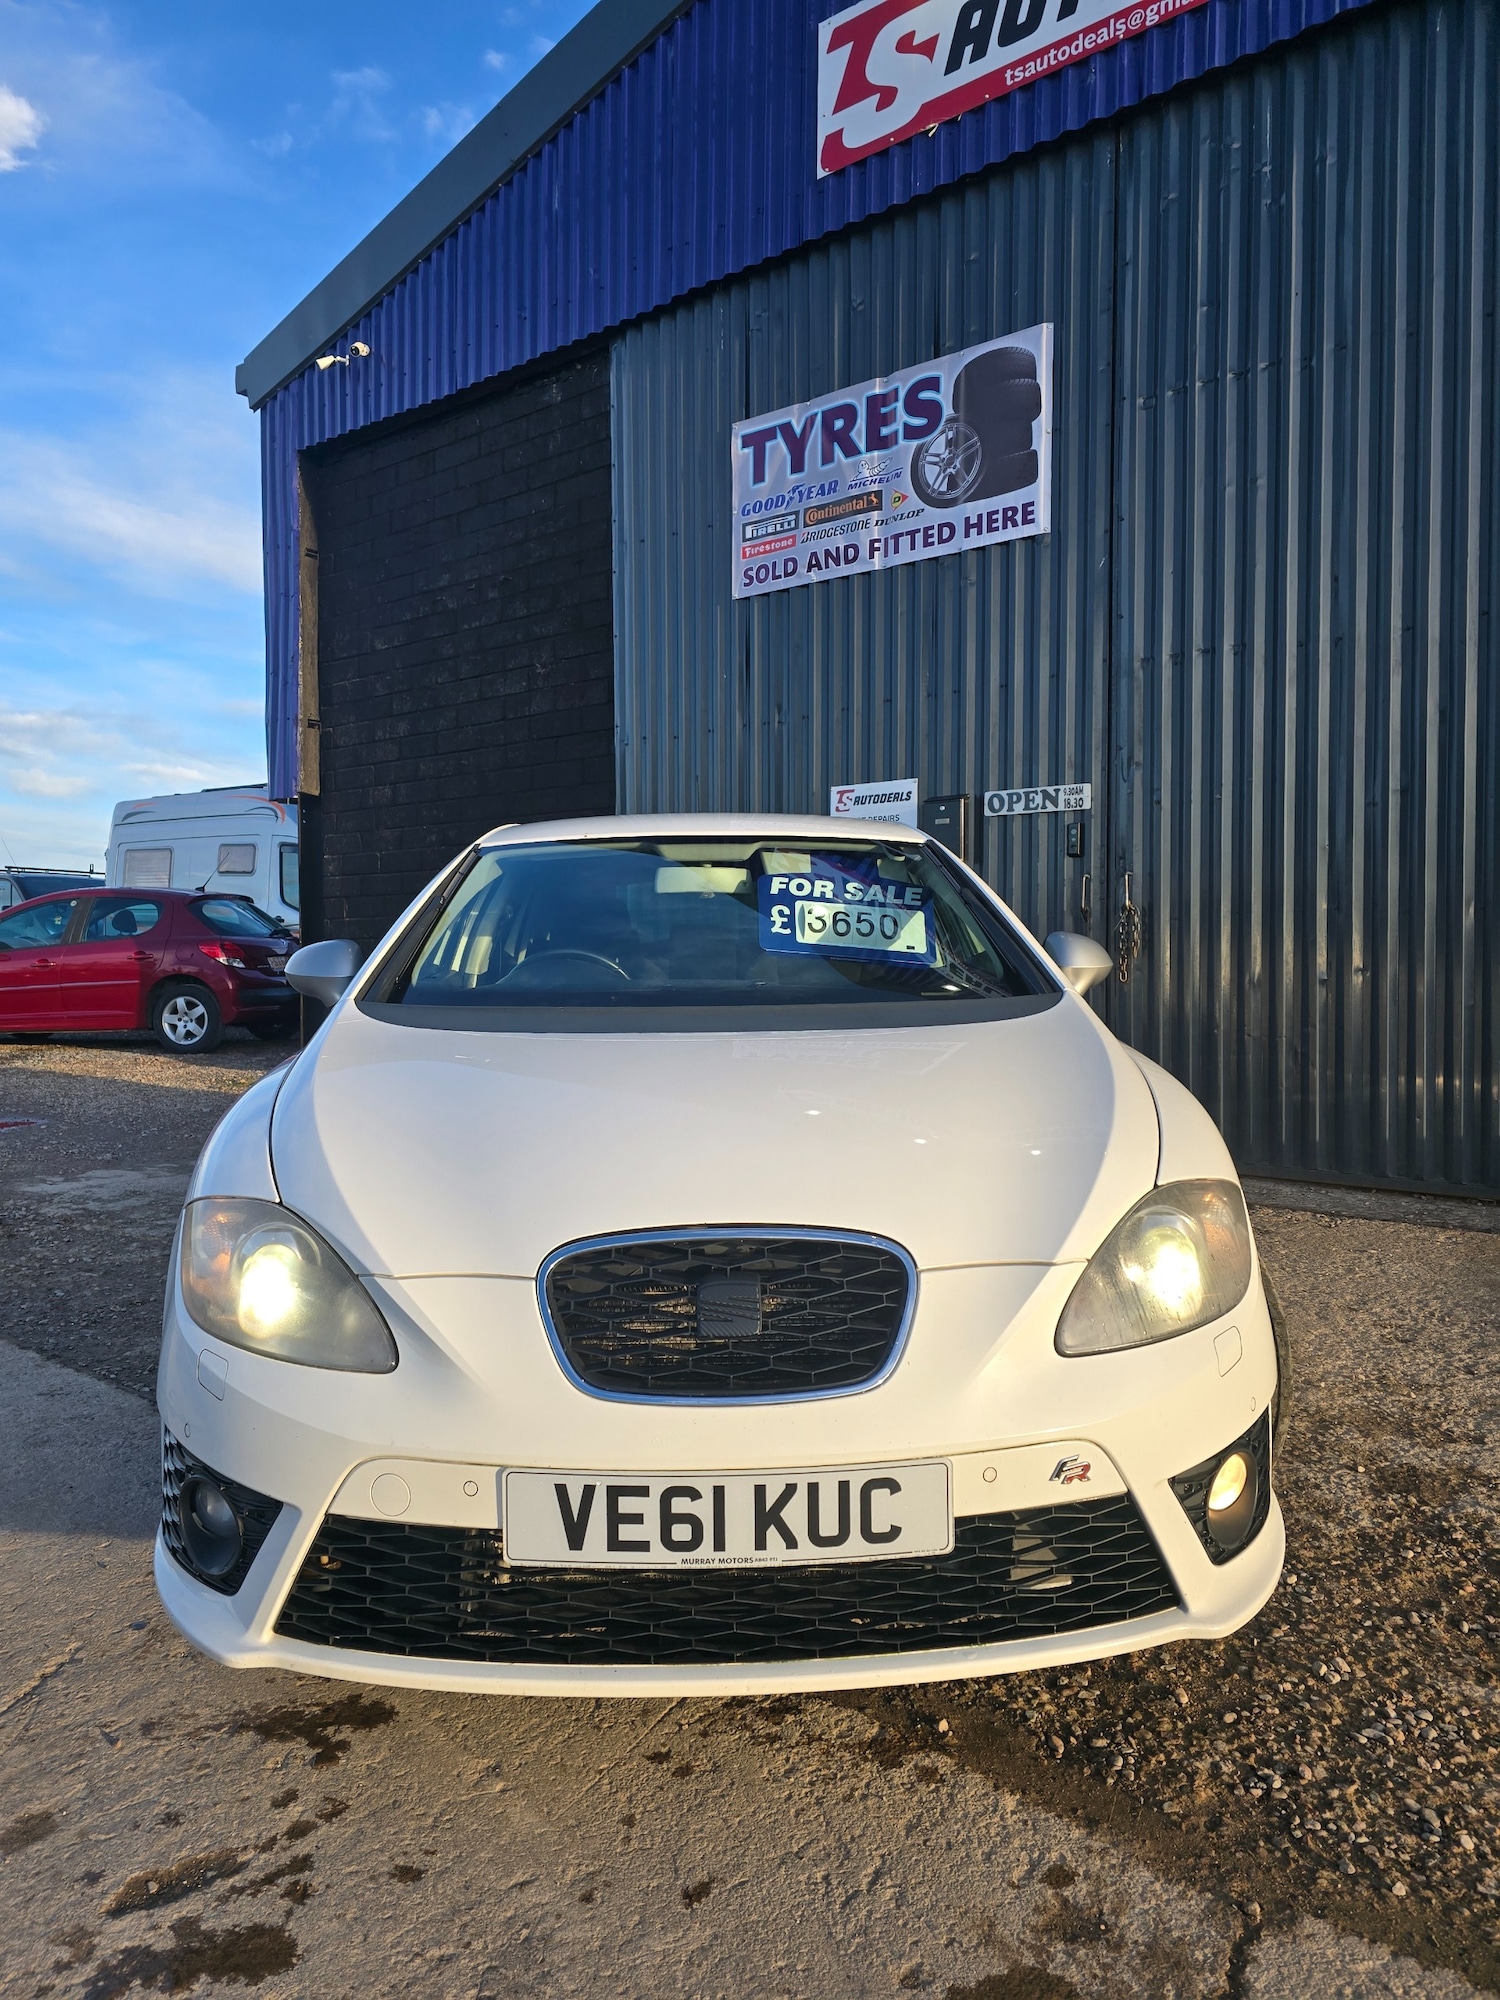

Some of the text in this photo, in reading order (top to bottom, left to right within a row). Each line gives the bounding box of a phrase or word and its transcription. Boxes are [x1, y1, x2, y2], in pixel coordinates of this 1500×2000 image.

[741, 376, 943, 485] TYRES
[847, 470, 903, 491] MICHELIN
[805, 495, 868, 525] Continental
[873, 508, 925, 527] DUNLOP
[745, 515, 796, 539] PIRELLI
[800, 518, 871, 544] BRIDGESTONE
[742, 501, 1036, 587] SOLD AND FITTED HERE
[744, 538, 793, 558] Firestone
[853, 791, 912, 806] AUTODEALS
[987, 788, 1060, 813] OPEN
[1064, 797, 1084, 809] 18.30
[770, 877, 923, 906] FOR SALE
[1048, 1454, 1091, 1485] FR
[554, 1477, 903, 1552] VE61 KUC
[718, 1557, 754, 1565] MOTORS
